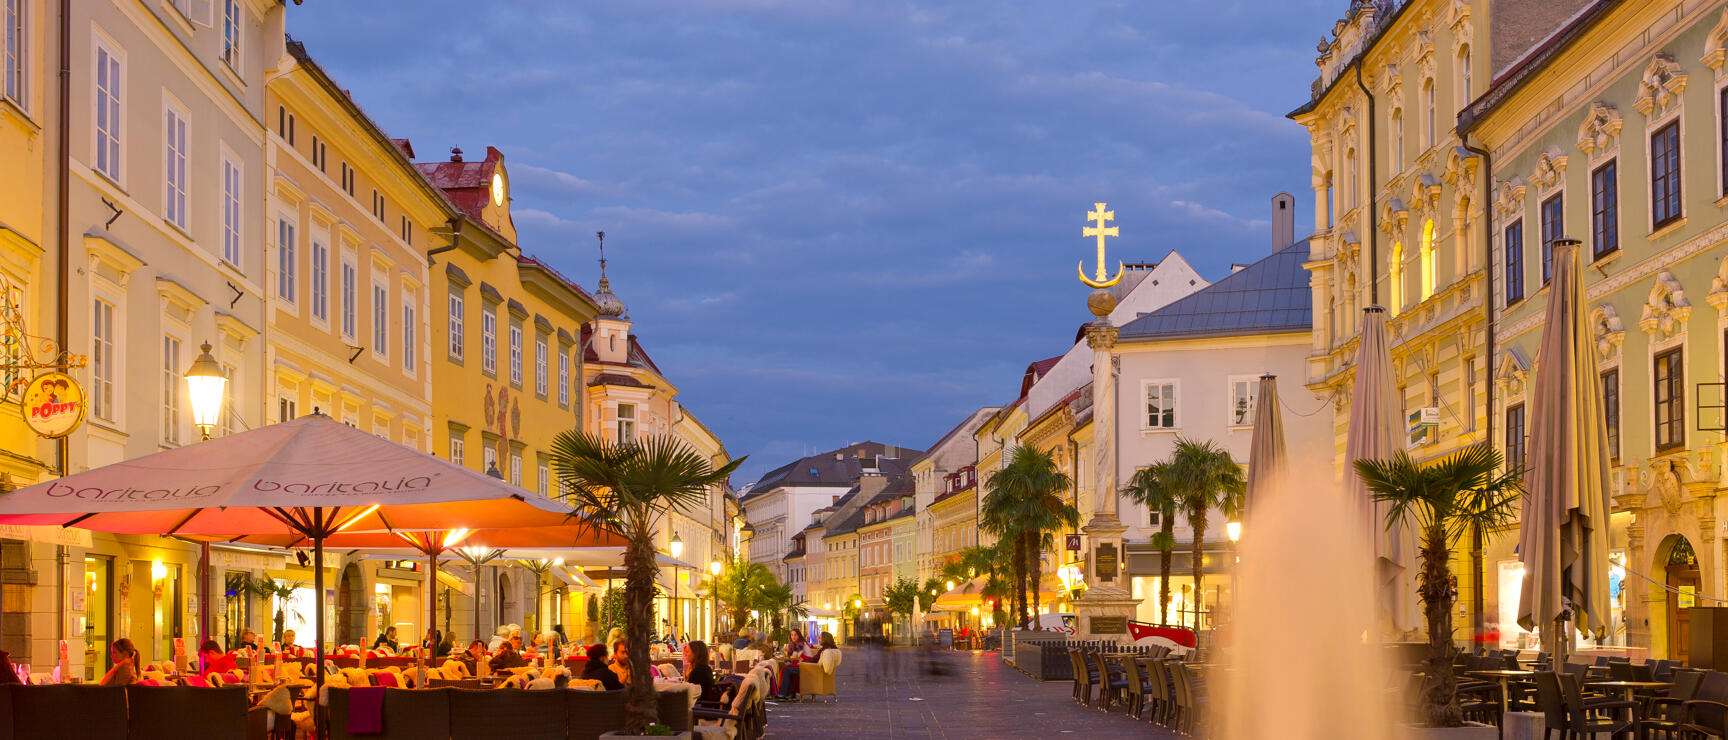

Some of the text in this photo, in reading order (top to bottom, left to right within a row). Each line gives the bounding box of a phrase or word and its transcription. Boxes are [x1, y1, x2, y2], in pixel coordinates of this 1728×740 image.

[32, 401, 77, 419] POPPY
[47, 482, 221, 500] baritalia
[254, 477, 431, 494] baritalia
